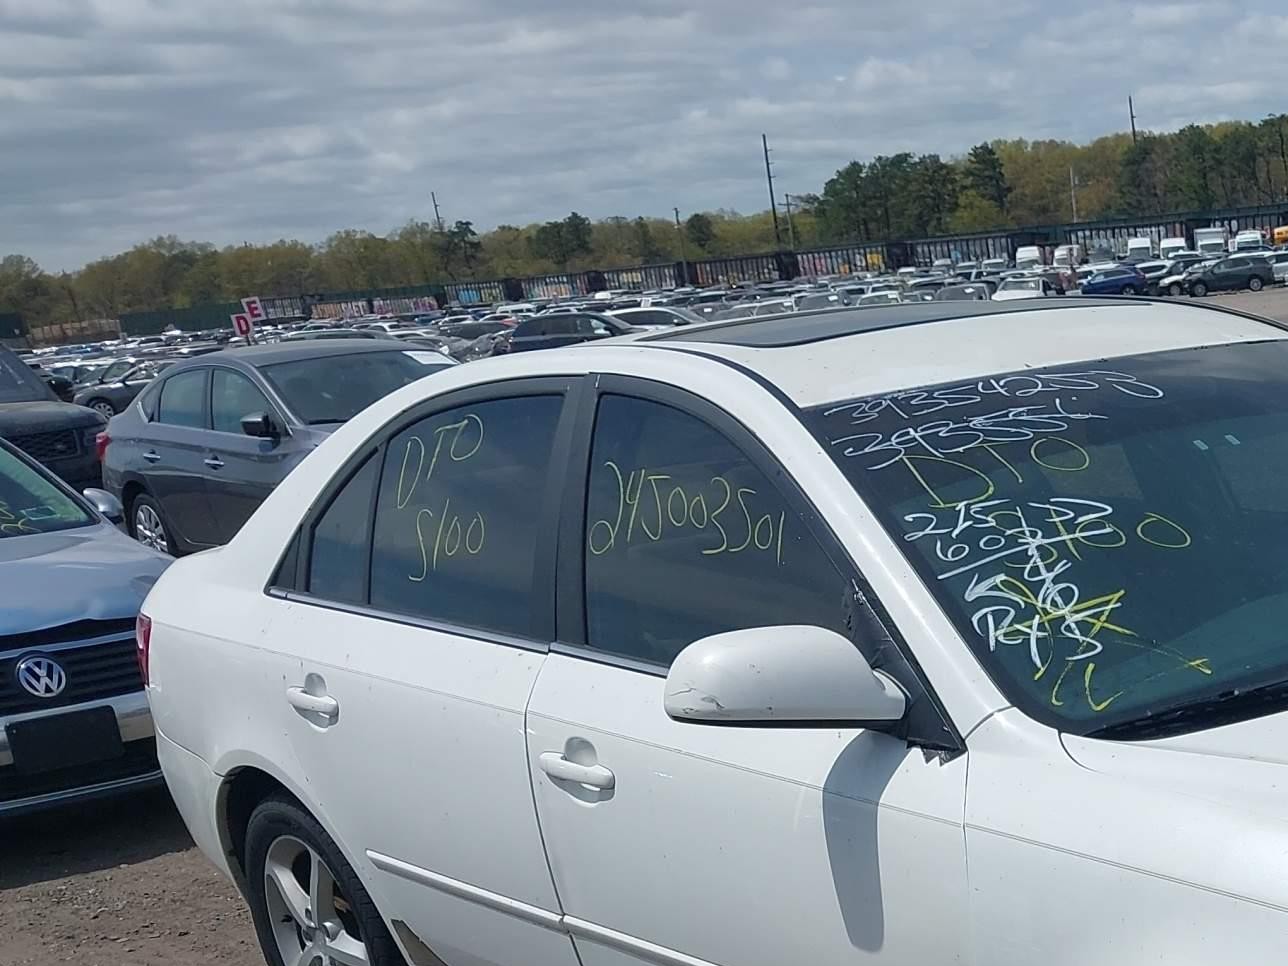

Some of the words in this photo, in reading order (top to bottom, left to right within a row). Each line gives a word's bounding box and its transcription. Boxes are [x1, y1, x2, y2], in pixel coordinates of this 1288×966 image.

[246, 300, 262, 318] E
[235, 315, 250, 336] D
[20, 658, 64, 696] VW
